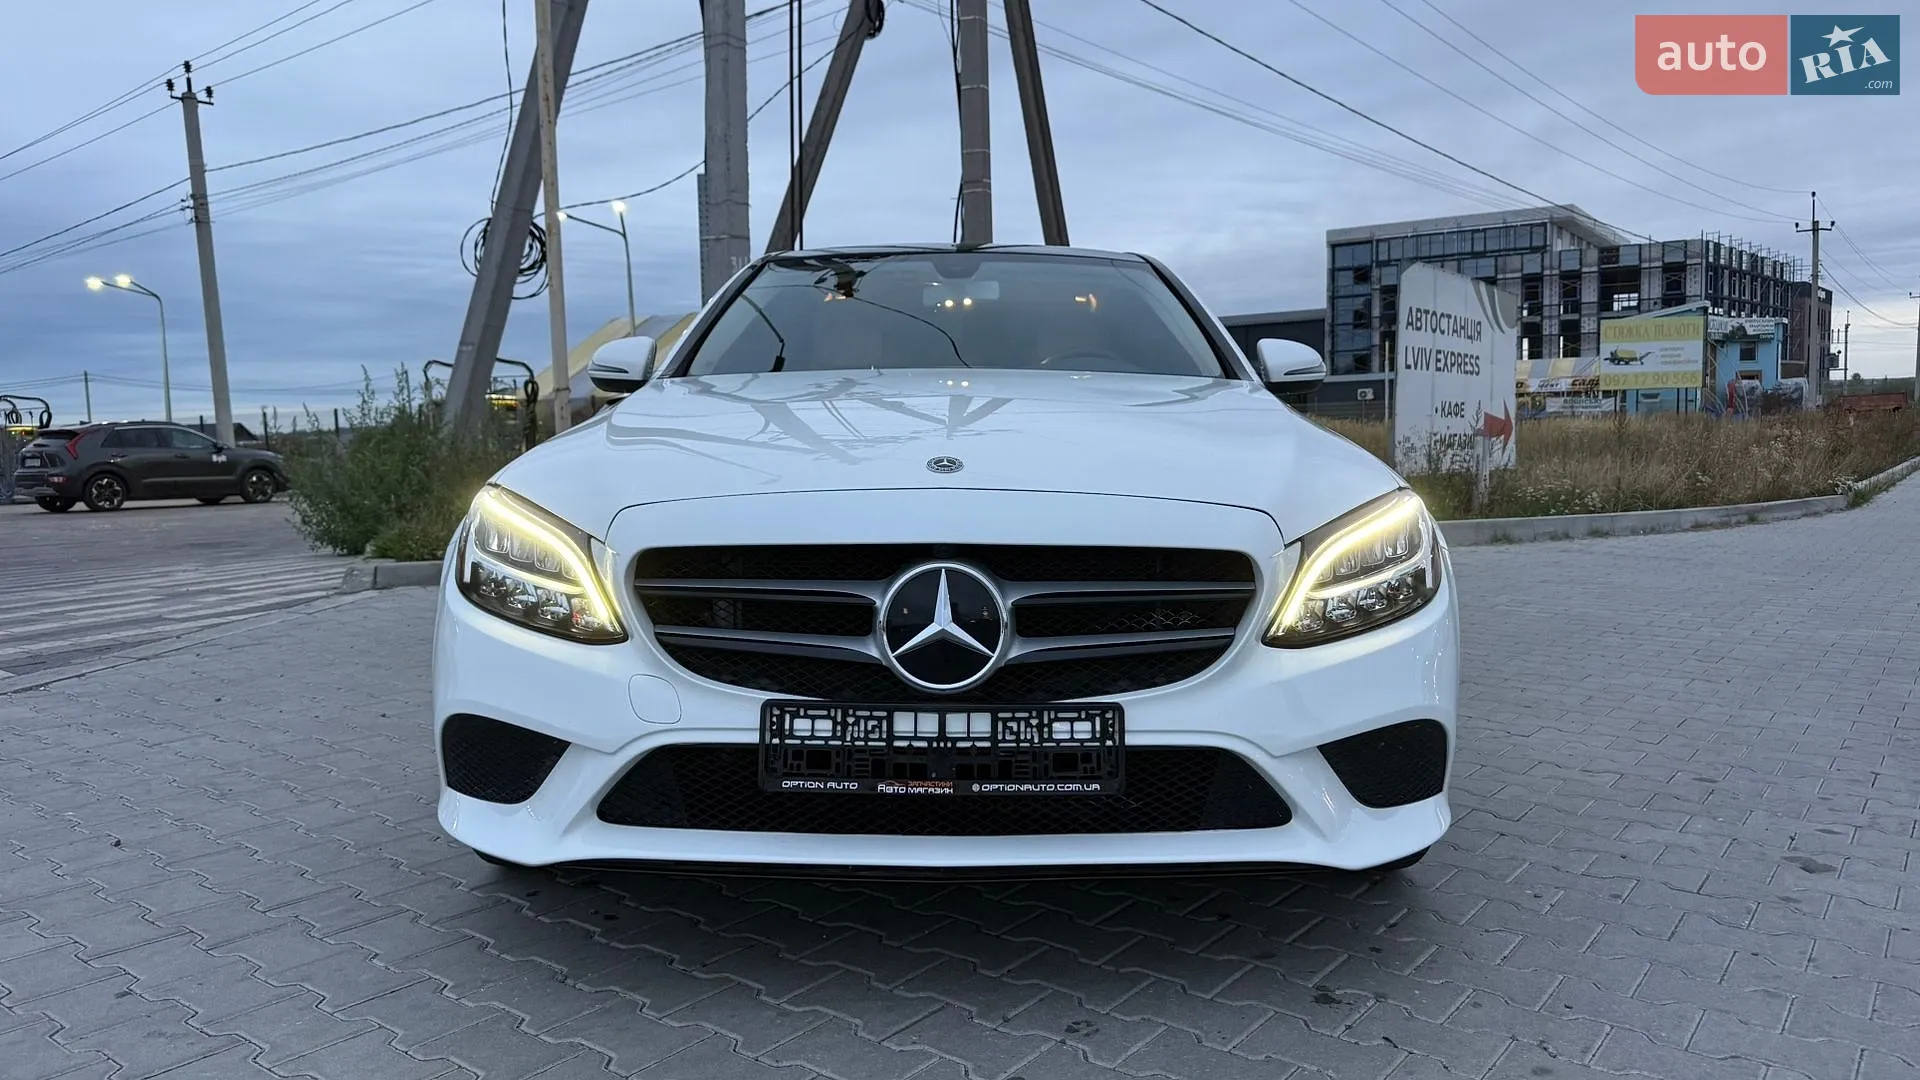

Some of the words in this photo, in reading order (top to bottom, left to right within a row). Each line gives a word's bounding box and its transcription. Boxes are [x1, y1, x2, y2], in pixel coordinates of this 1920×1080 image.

[1405, 306, 1482, 344] АВТОСТАНЦІЯ
[1404, 346, 1432, 371] LVIV
[1435, 349, 1481, 376] EXPRESS
[1440, 400, 1465, 418] КАФЕ
[826, 781, 859, 790] AUTO
